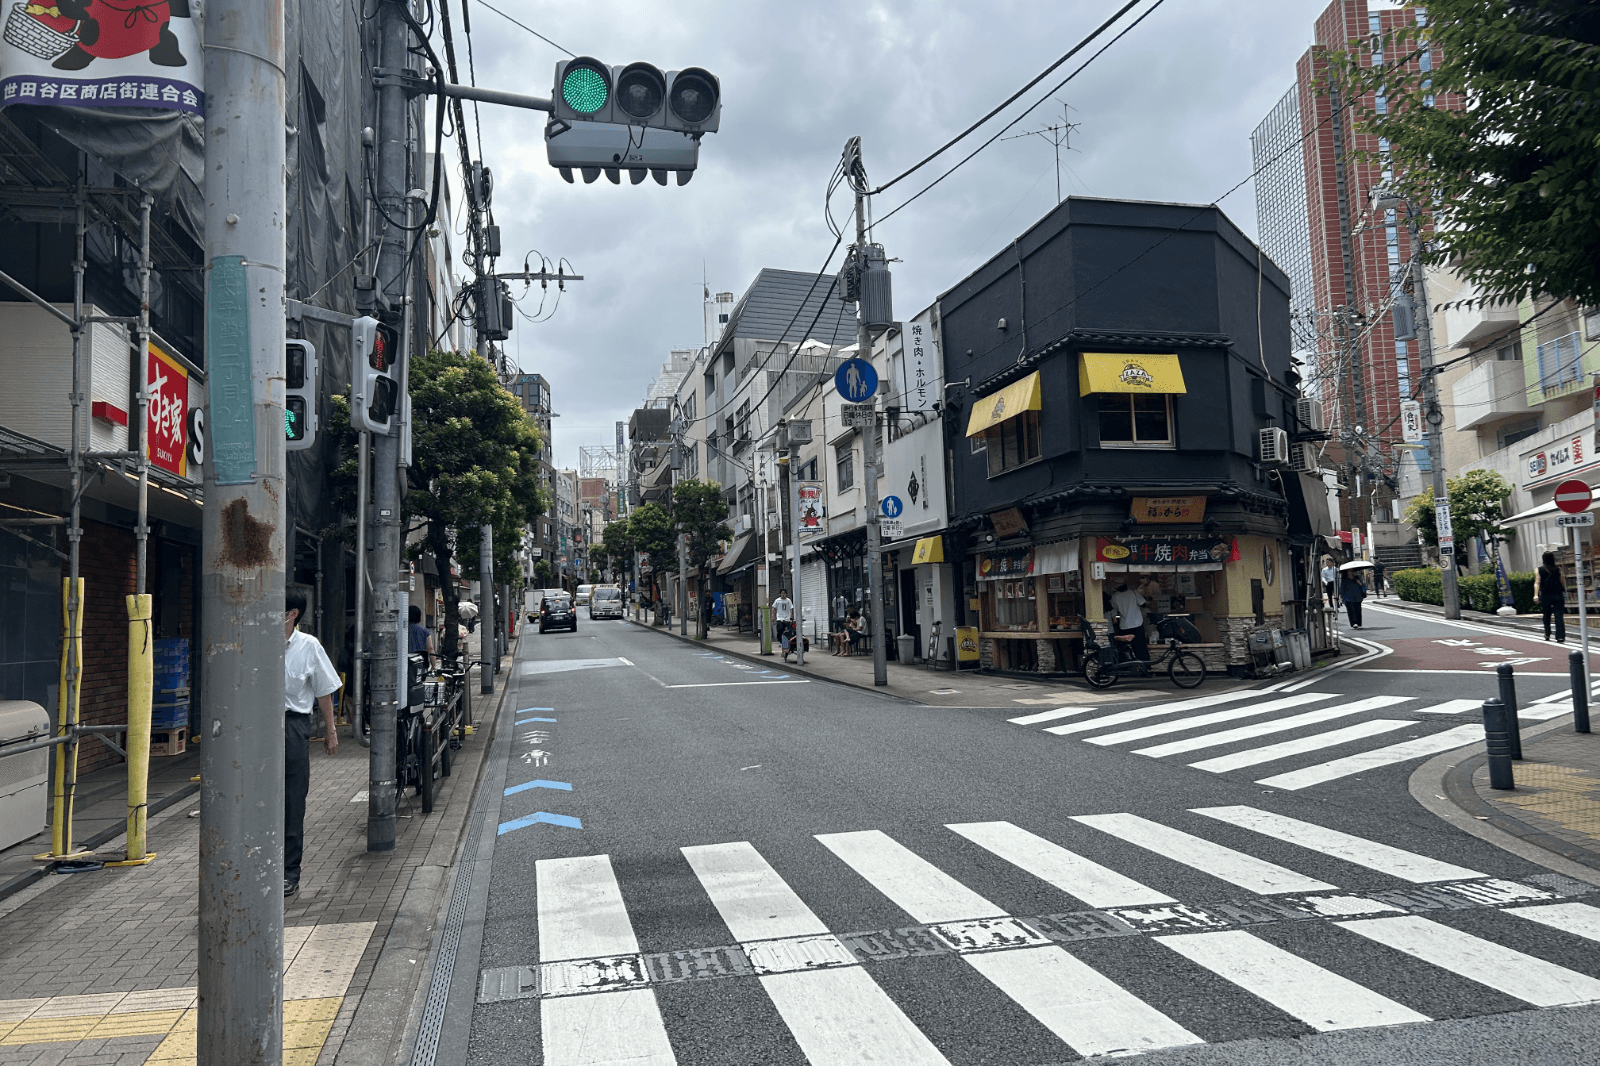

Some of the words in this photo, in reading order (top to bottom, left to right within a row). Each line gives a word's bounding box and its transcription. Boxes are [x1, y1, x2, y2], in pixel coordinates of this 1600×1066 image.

[3, 81, 199, 108] 世田谷区商店街連合会
[911, 324, 927, 408] 焼き肉・ホルモン
[147, 362, 183, 449] すき家
[864, 418, 873, 426] 17
[156, 447, 173, 463] SUKIYA
[1550, 446, 1570, 466] セイムス
[1147, 506, 1182, 518] 福のから
[1558, 515, 1592, 526] 自転車を除く
[1138, 543, 1208, 562] 牛焼肉弁当
